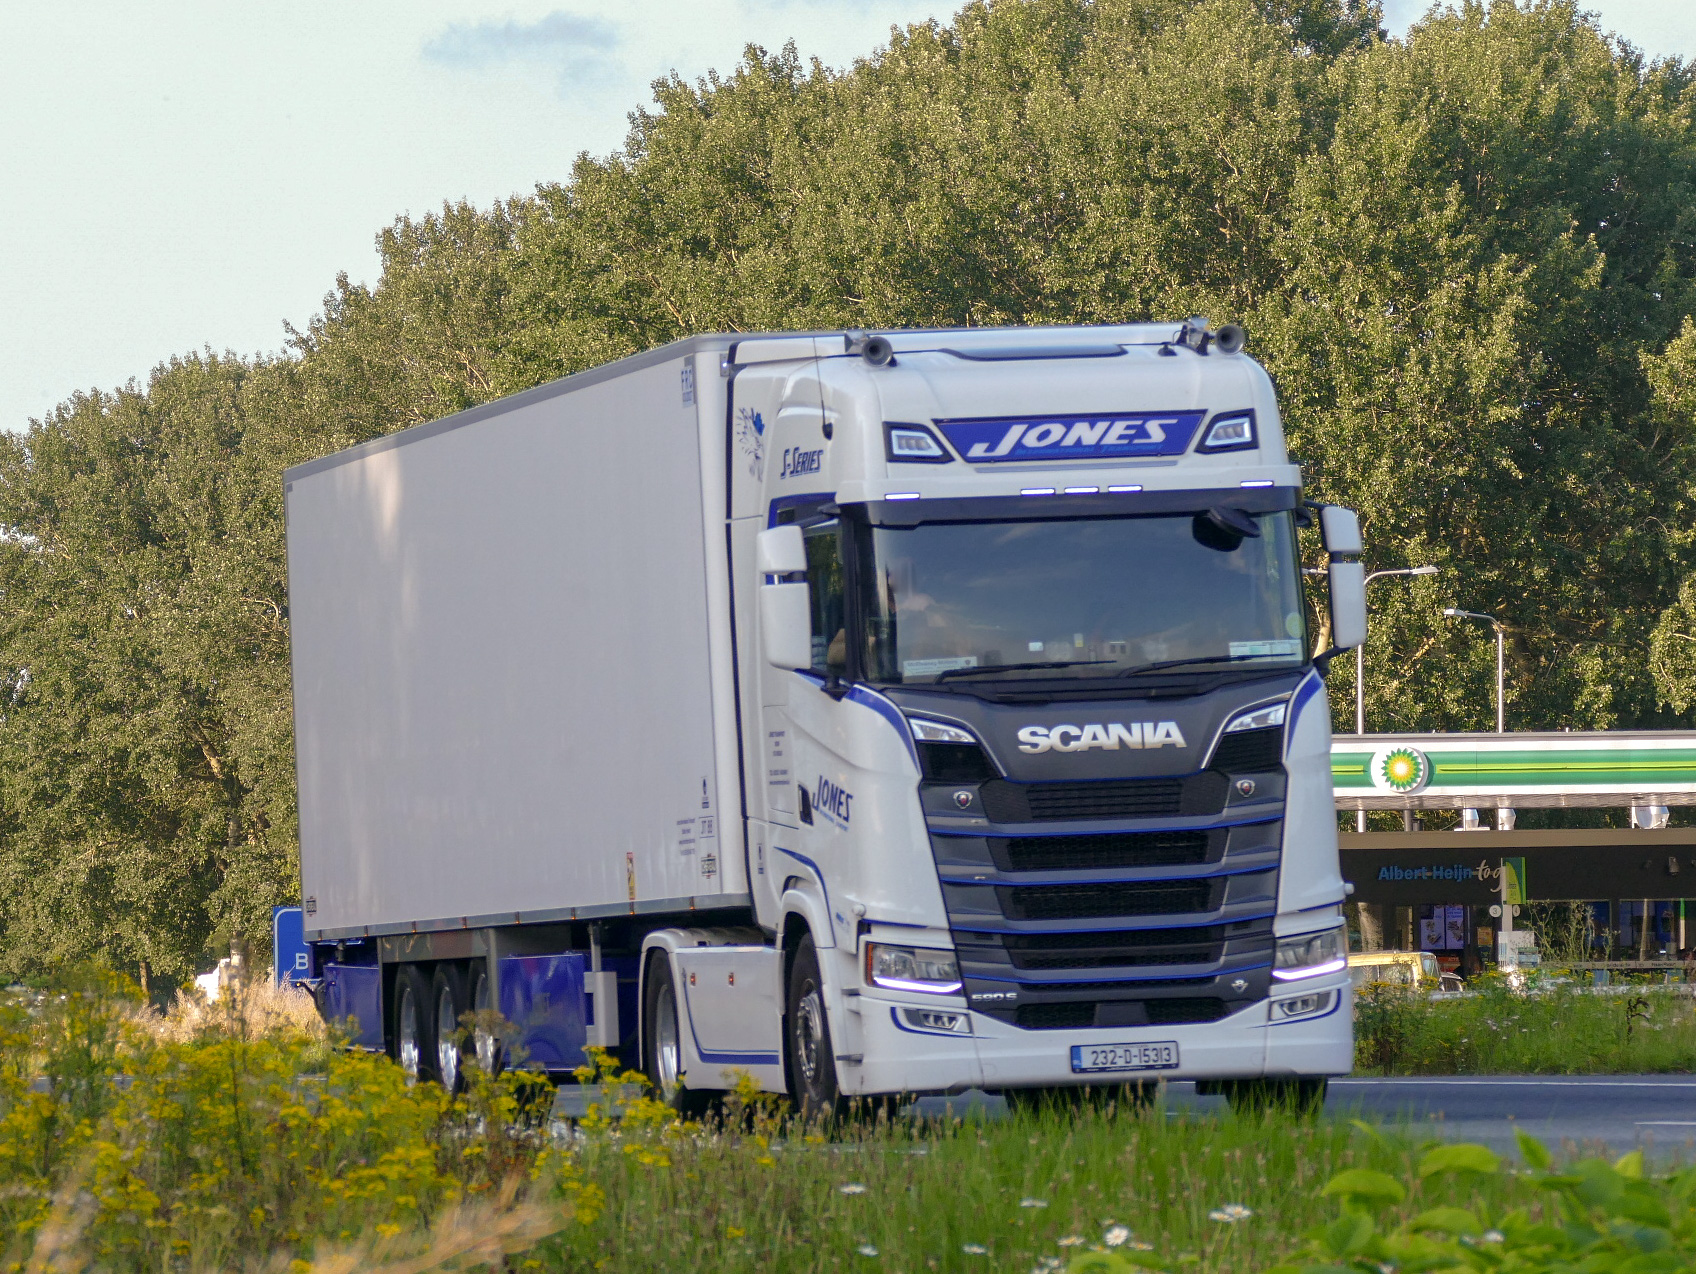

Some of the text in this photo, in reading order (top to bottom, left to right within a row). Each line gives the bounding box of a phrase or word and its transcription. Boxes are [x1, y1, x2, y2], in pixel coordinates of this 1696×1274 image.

[967, 419, 1178, 457] JONES
[1017, 721, 1187, 754] SCANIA
[812, 774, 853, 823] JONES
[1378, 865, 1428, 881] Albert
[1432, 865, 1472, 882] Heijn
[1091, 1046, 1172, 1066] 232-D-15313
